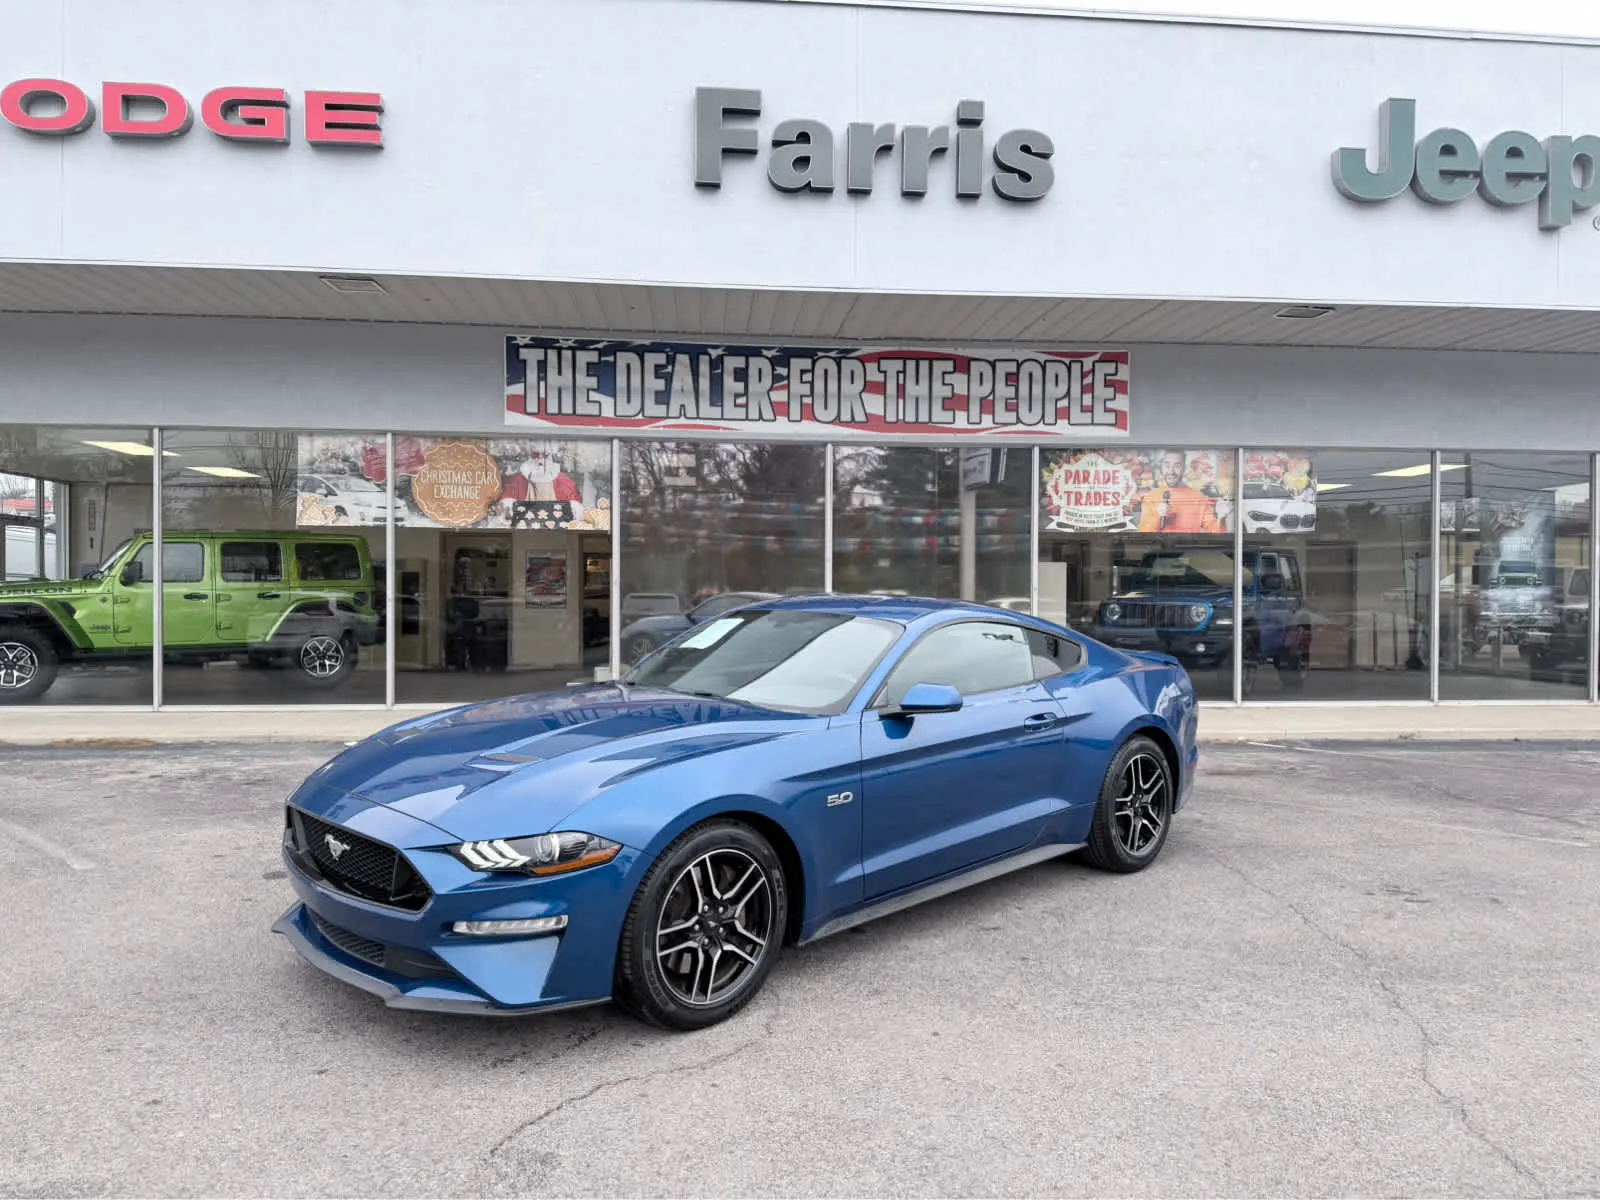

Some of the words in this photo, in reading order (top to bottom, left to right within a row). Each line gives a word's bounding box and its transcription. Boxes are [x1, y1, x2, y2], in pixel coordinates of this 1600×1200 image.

[695, 86, 1055, 201] Farris
[1331, 97, 1600, 231] Jeep
[518, 346, 602, 417] THE
[613, 350, 776, 421] DEALER
[788, 355, 868, 424] FOR
[878, 357, 957, 424] THE
[967, 358, 1119, 426] PEOPLE
[420, 470, 473, 485] CHRISTMAS
[475, 471, 493, 487] CAR
[1064, 469, 1121, 485] PARADE
[433, 484, 481, 499] EXCHANGE
[1063, 490, 1121, 506] TRADES
[826, 791, 854, 807] 5.0
